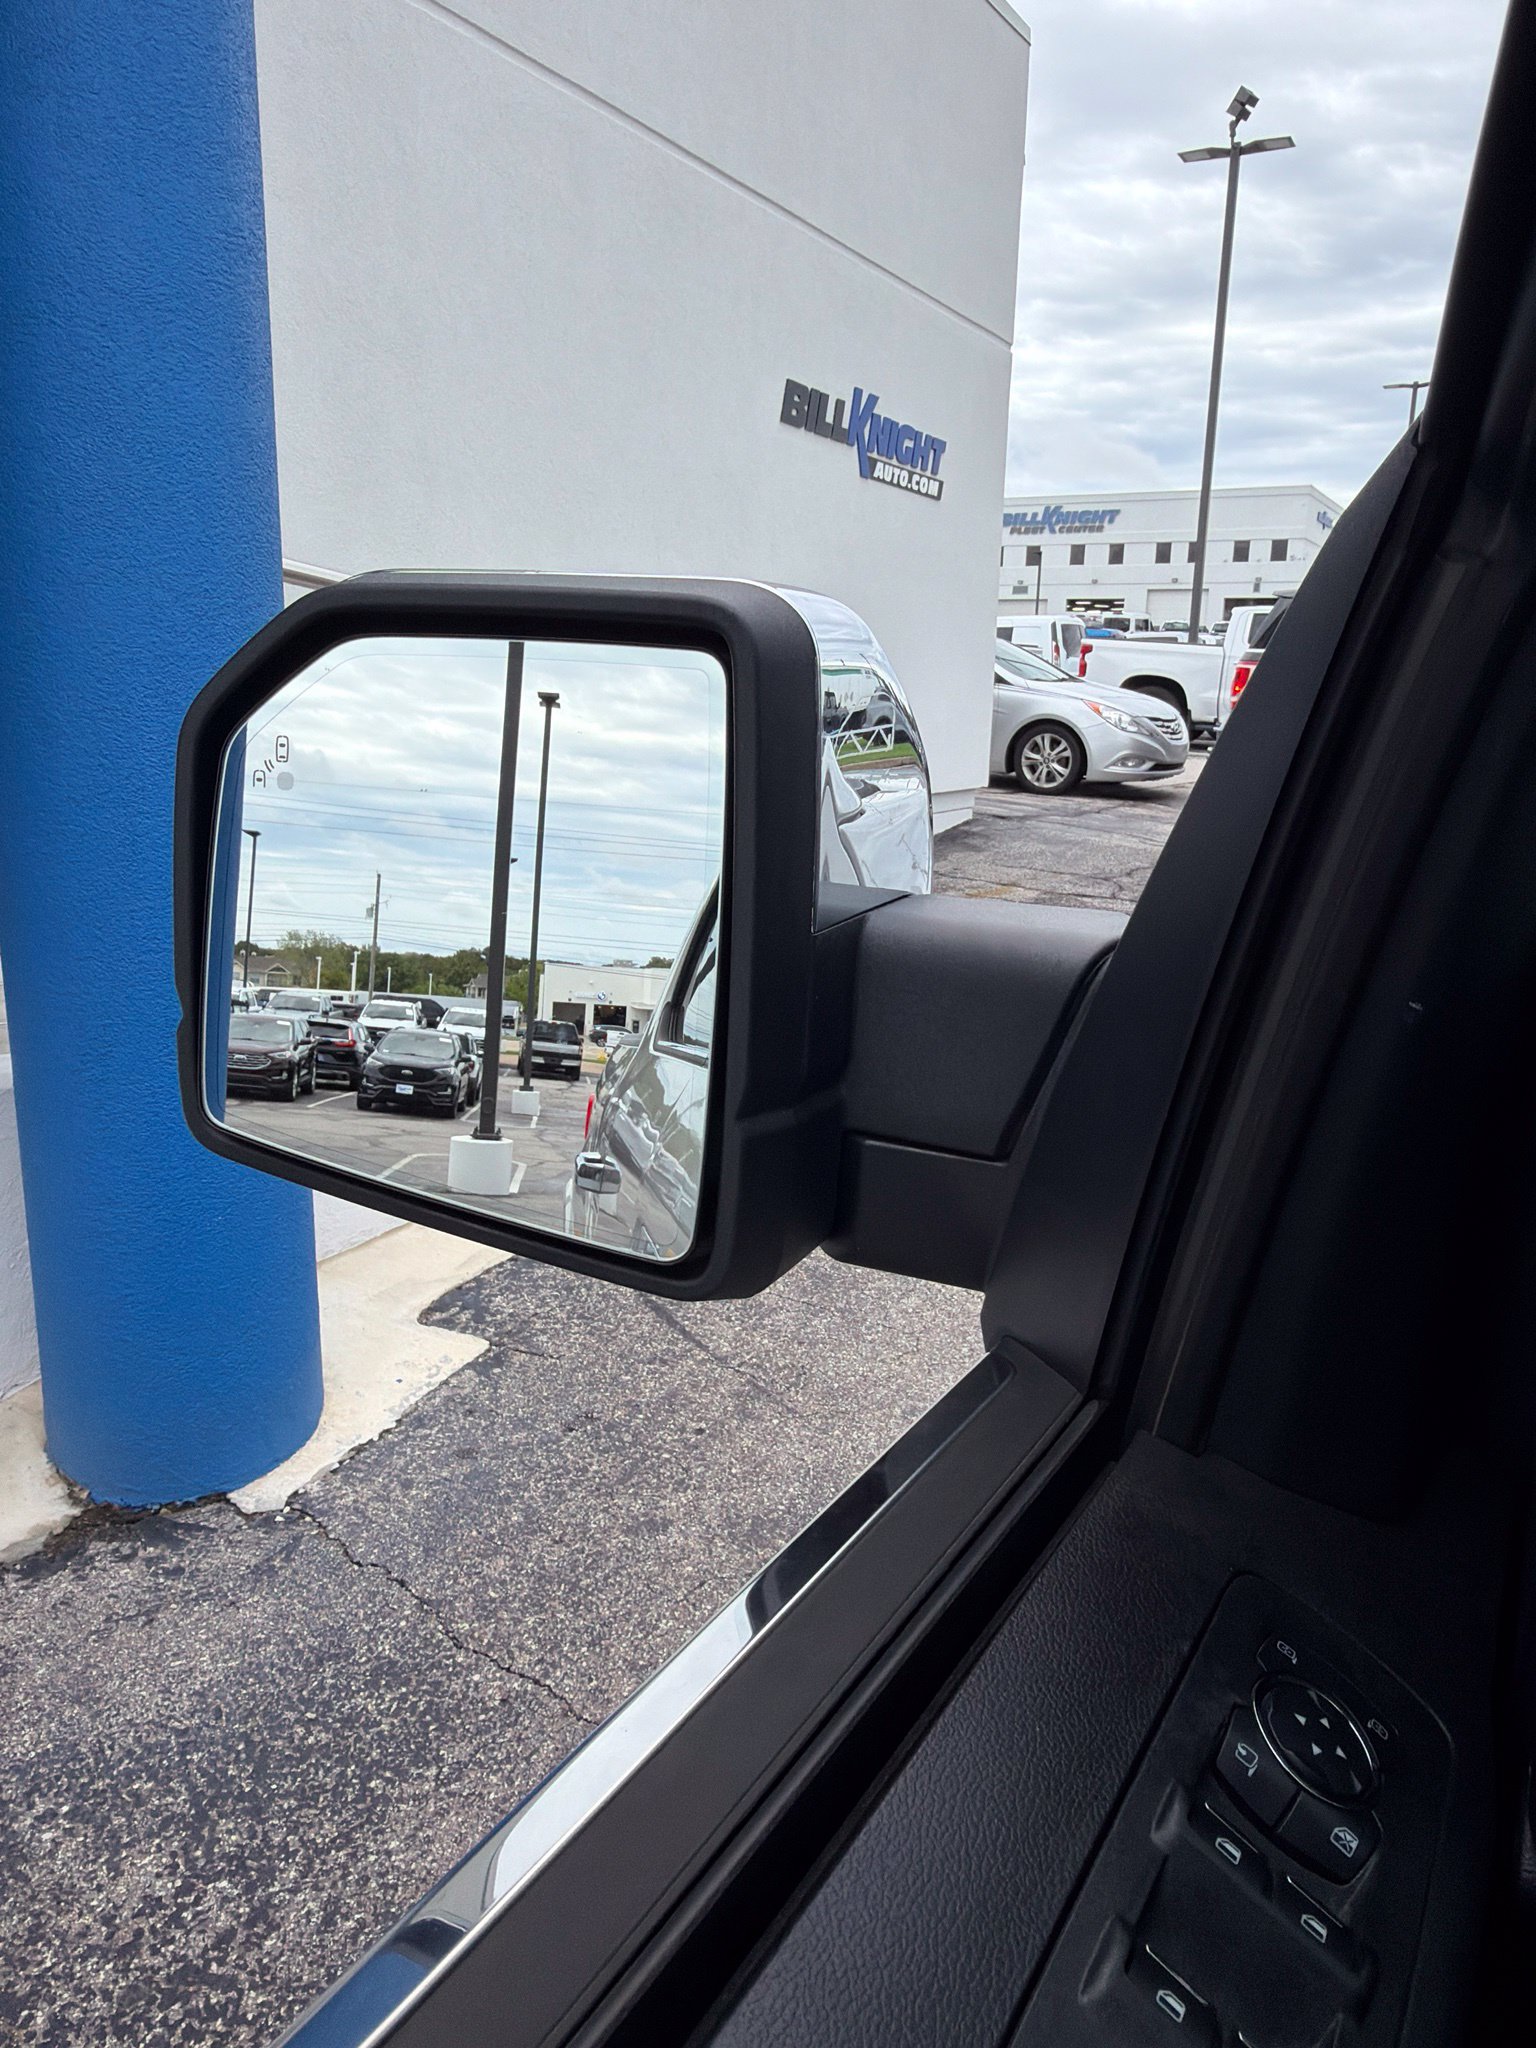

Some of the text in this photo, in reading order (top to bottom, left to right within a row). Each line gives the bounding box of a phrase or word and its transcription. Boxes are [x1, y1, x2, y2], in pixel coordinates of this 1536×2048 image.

[780, 378, 947, 480] BILL KNIGHT
[873, 461, 940, 497] AUTO.COM
[1041, 505, 1121, 534] KNIGHT
[1058, 524, 1105, 534] CENTER
